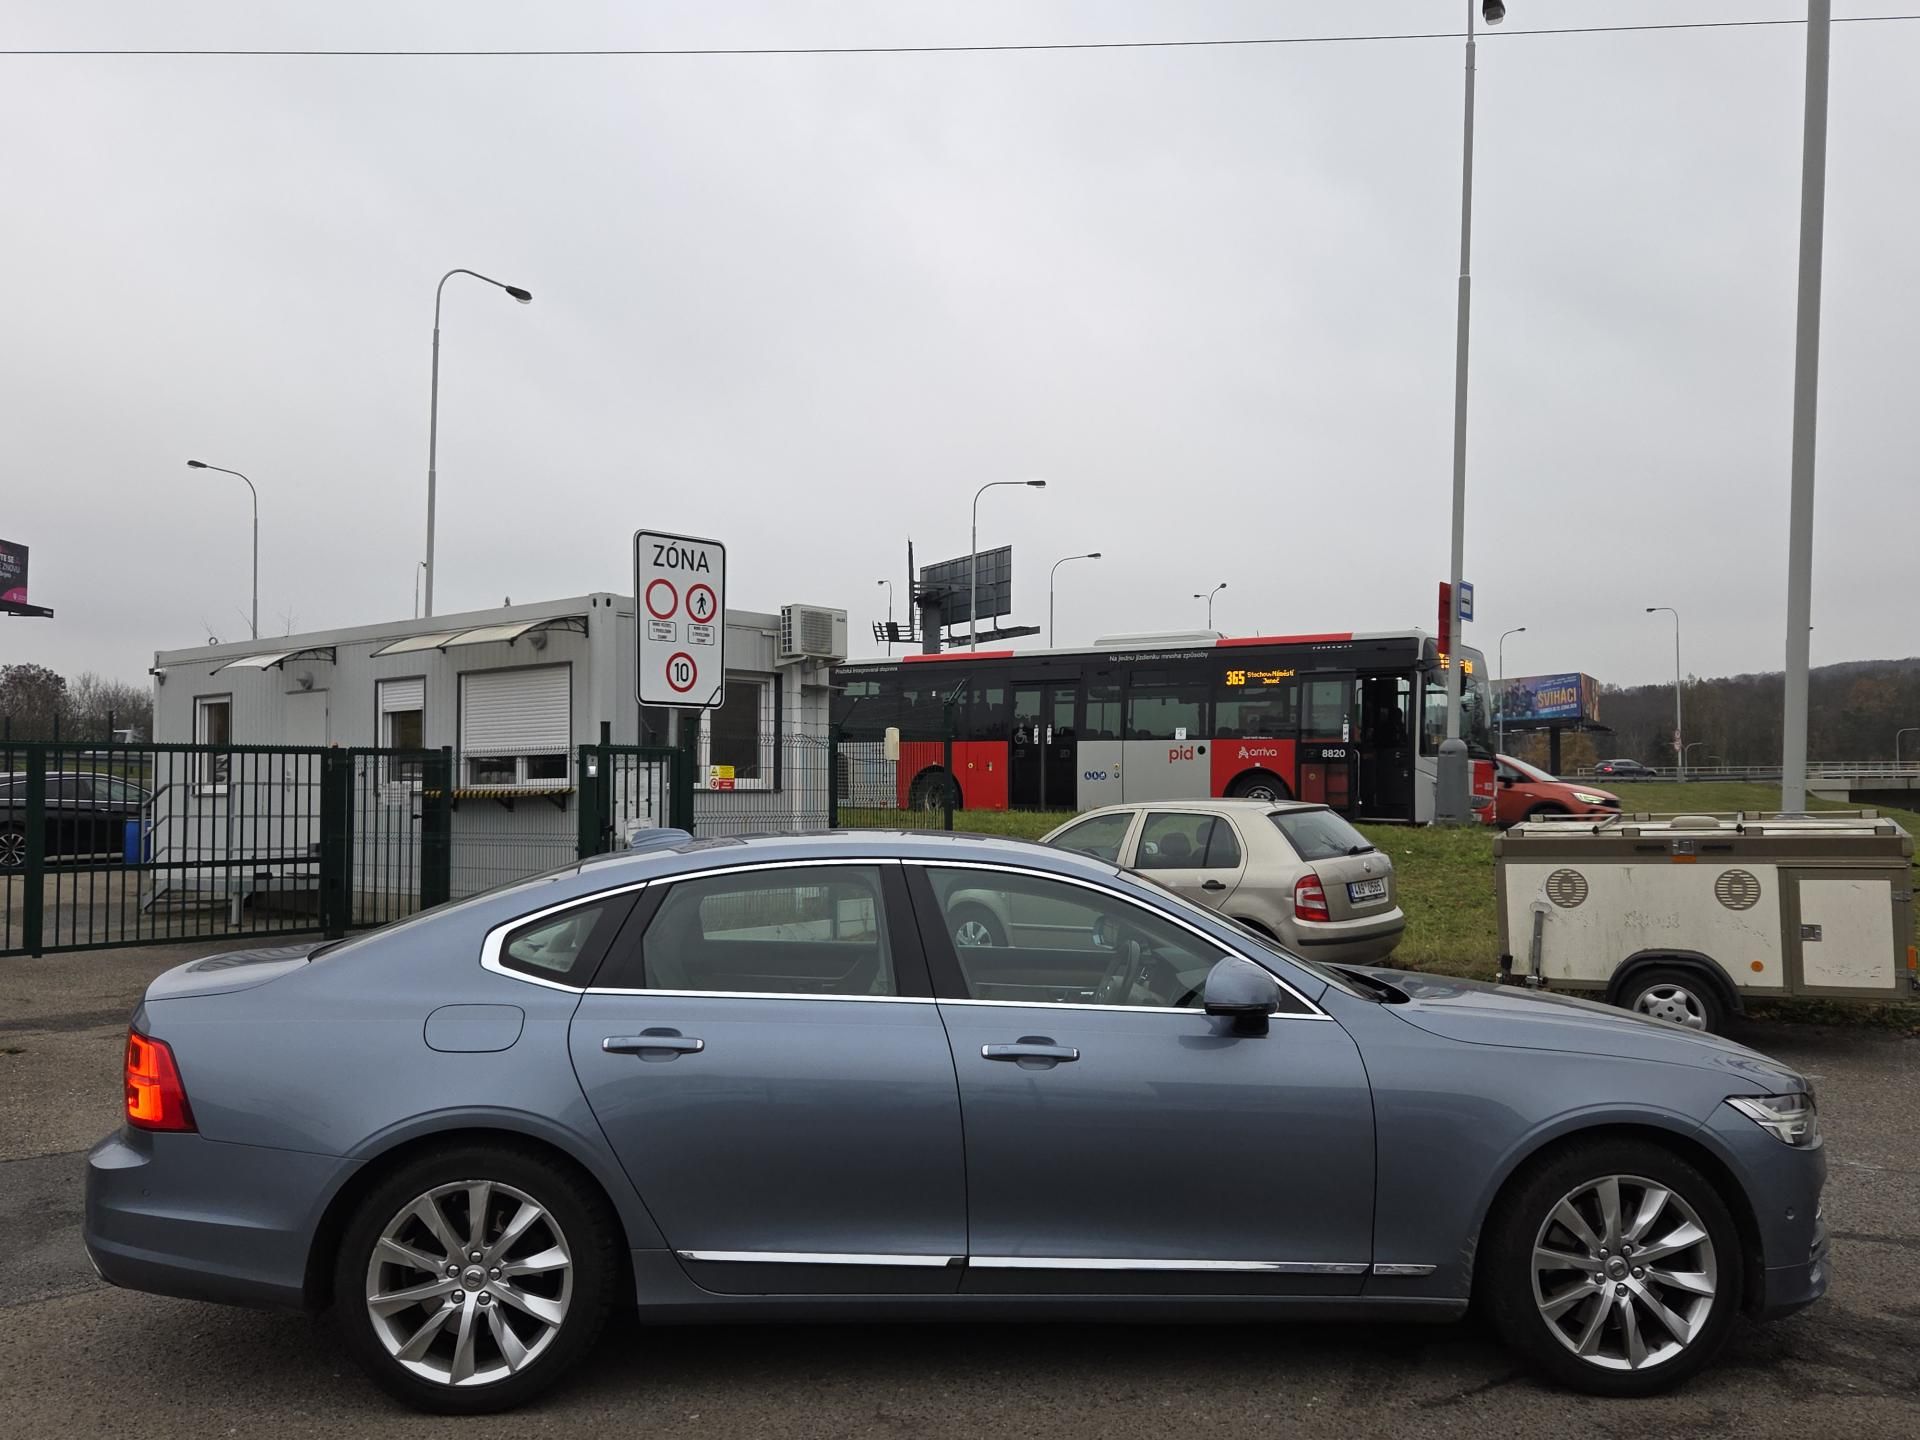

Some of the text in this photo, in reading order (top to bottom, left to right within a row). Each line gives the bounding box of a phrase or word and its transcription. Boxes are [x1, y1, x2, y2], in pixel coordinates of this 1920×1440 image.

[653, 541, 710, 573] ZÓNA
[674, 662, 689, 682] 10
[1226, 670, 1245, 685] 365
[1168, 745, 1194, 763] pid
[1250, 746, 1277, 757] arriva
[1321, 749, 1346, 758] 8820
